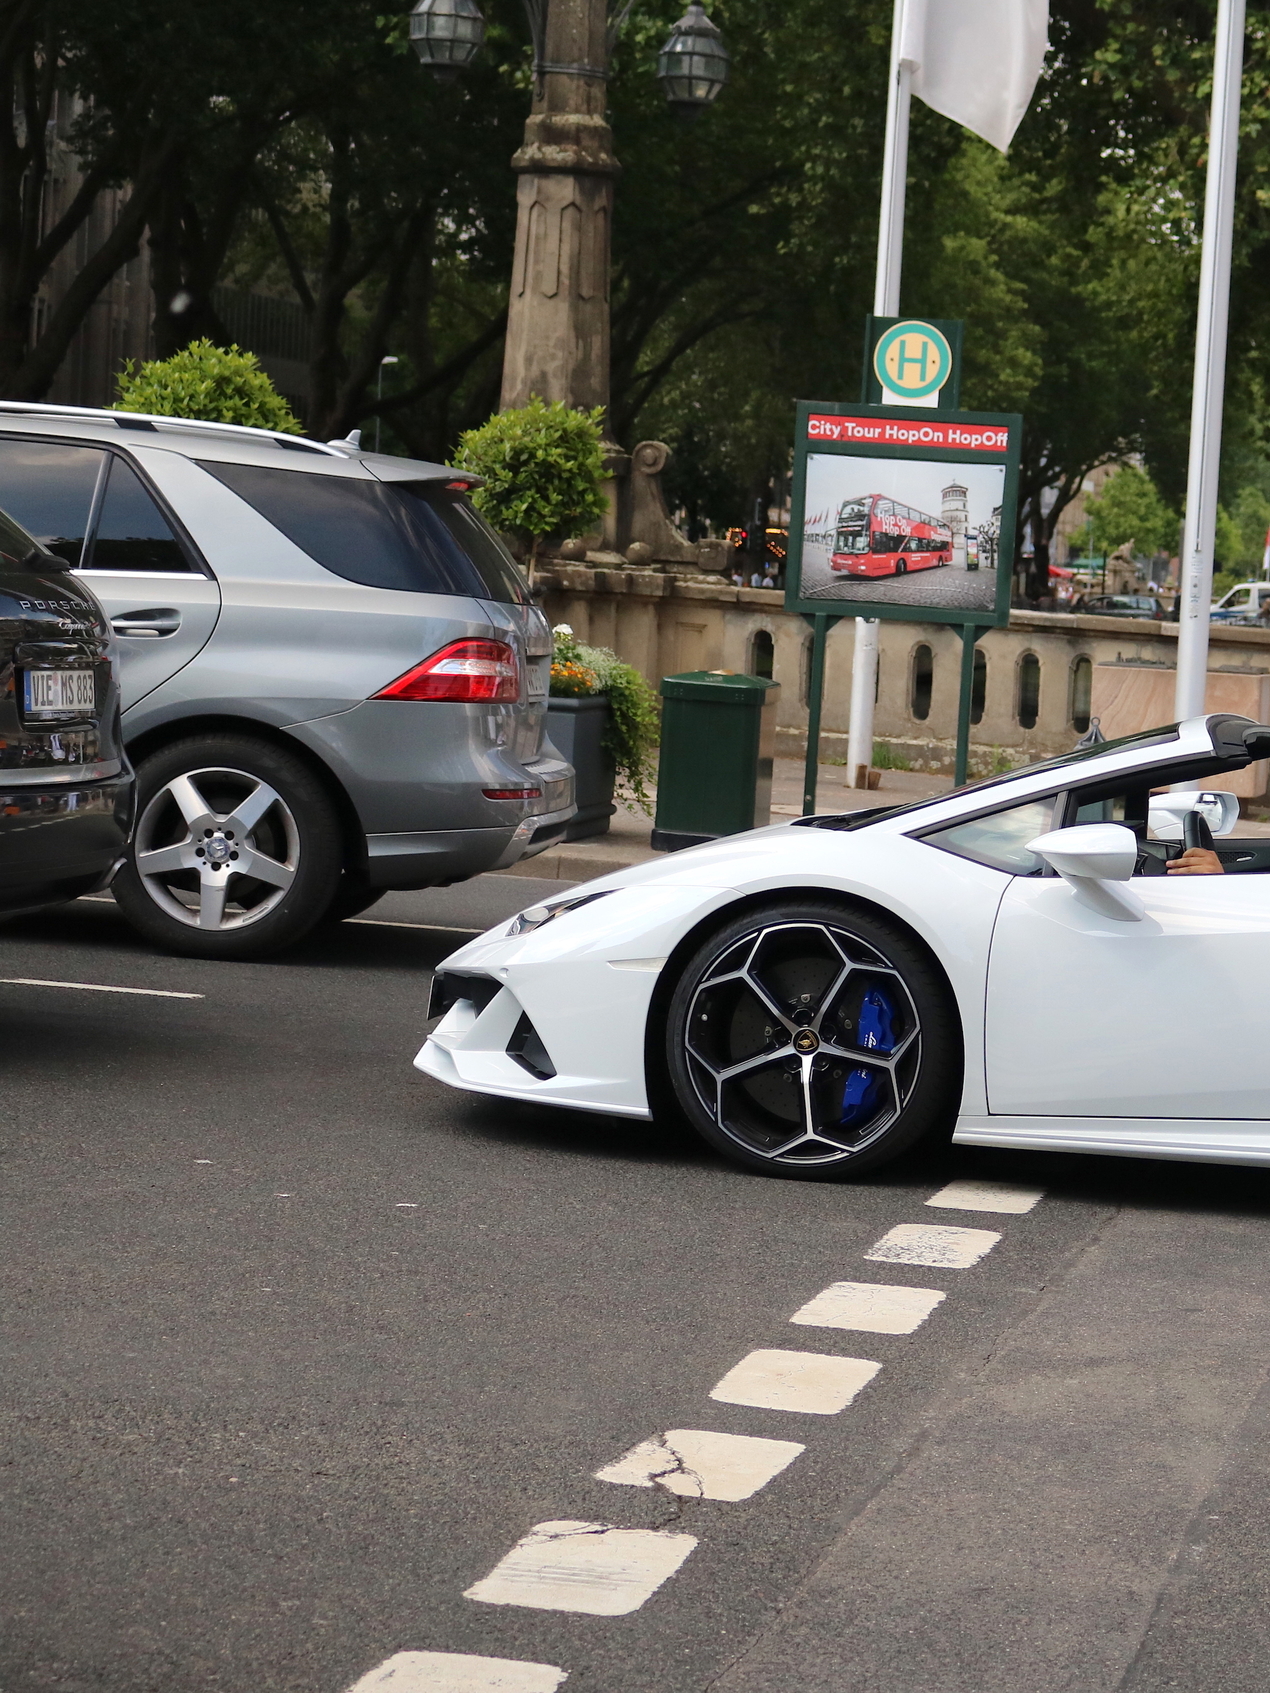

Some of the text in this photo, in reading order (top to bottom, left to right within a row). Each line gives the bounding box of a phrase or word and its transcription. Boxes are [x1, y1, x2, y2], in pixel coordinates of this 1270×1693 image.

[897, 340, 928, 382] H
[808, 420, 1008, 447] City Tour HopOn HopOff
[878, 510, 896, 527] Hop
[898, 516, 908, 526] On
[883, 522, 912, 536] Hop Off
[20, 600, 96, 610] PORSCHE
[32, 673, 94, 706] VIE MS 883
